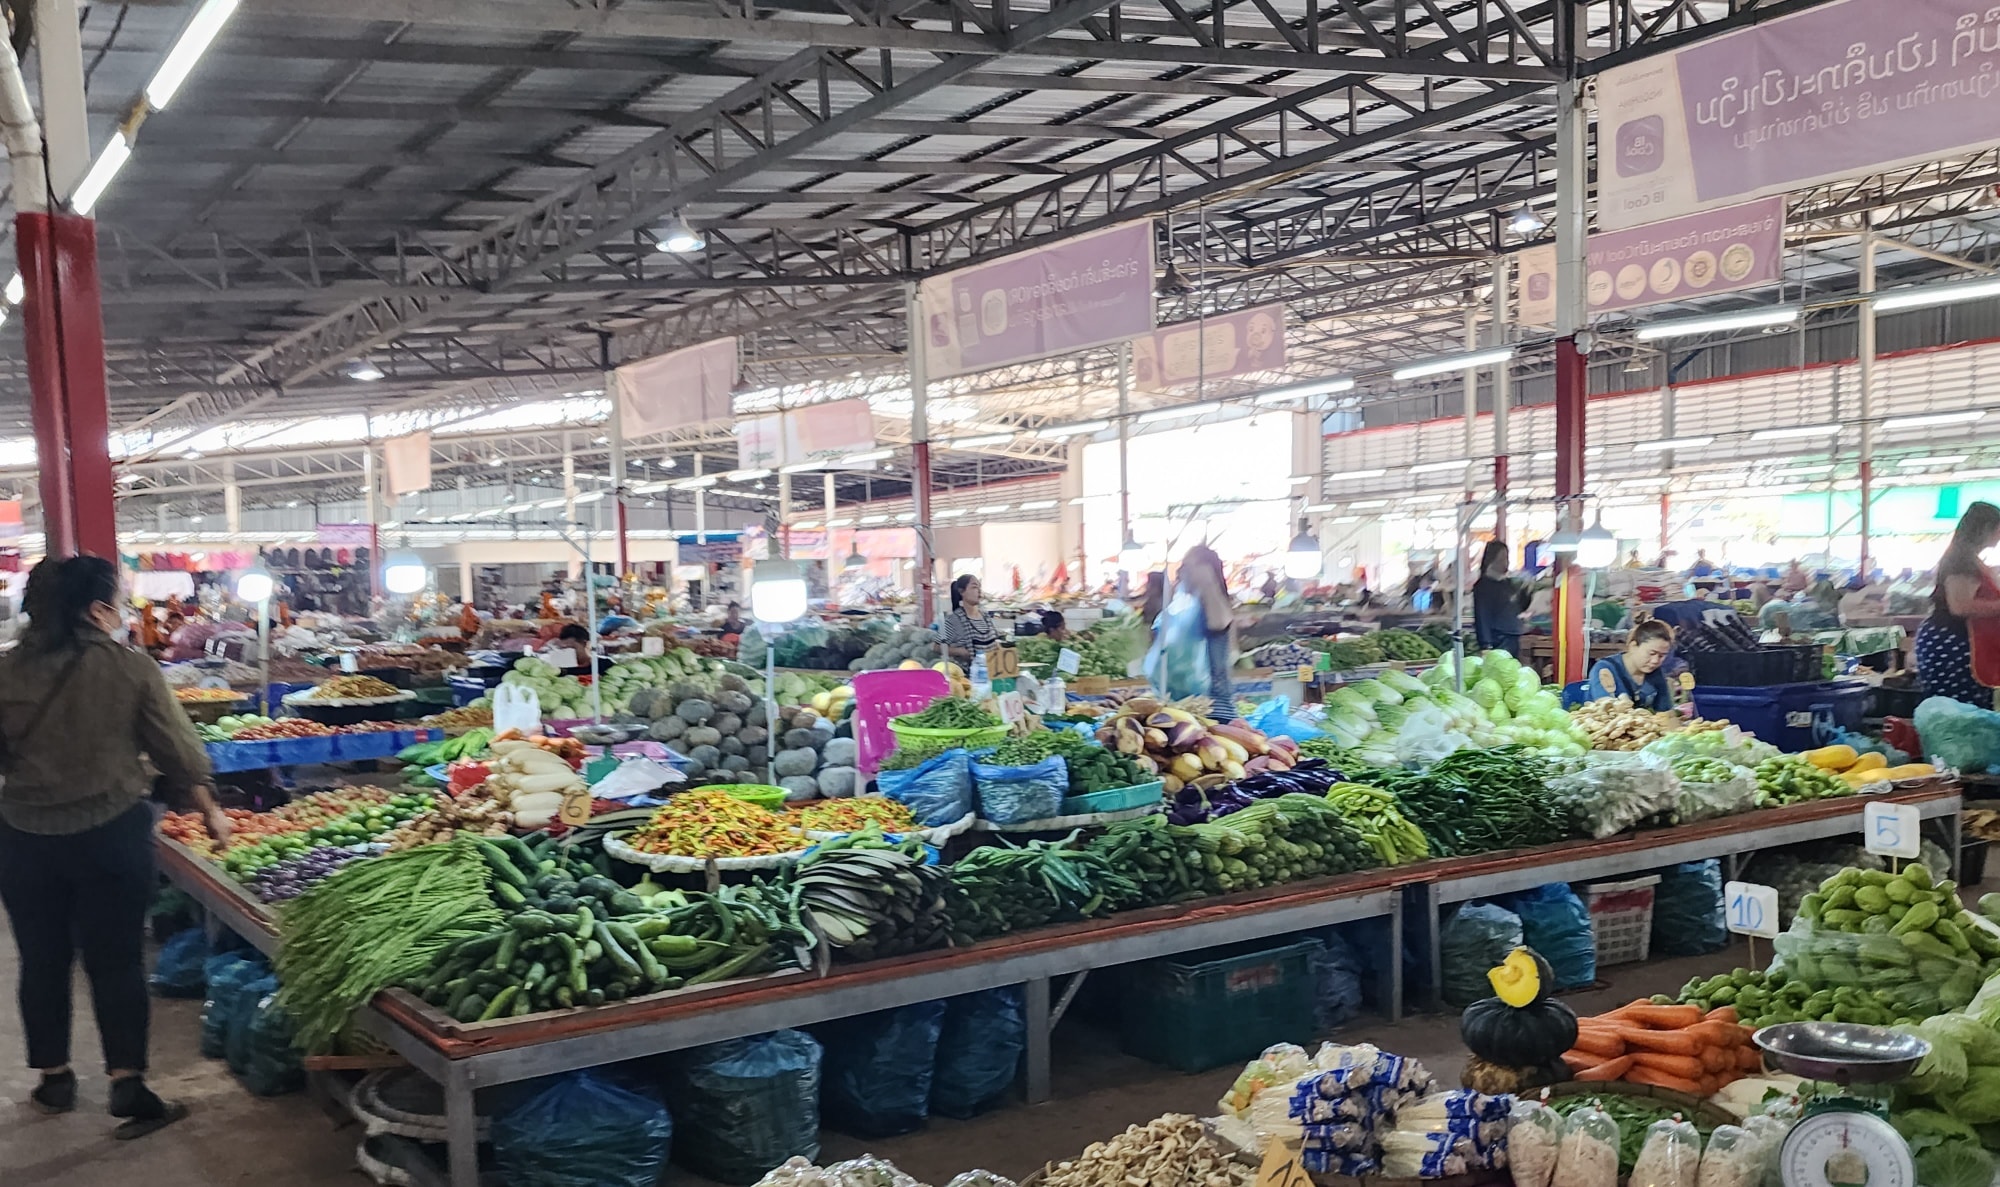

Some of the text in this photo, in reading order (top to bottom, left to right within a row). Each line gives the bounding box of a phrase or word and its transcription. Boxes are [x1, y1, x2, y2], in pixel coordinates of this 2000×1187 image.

[988, 649, 1018, 677] 10
[1875, 815, 1901, 847] 5
[1731, 894, 1763, 929] 10
